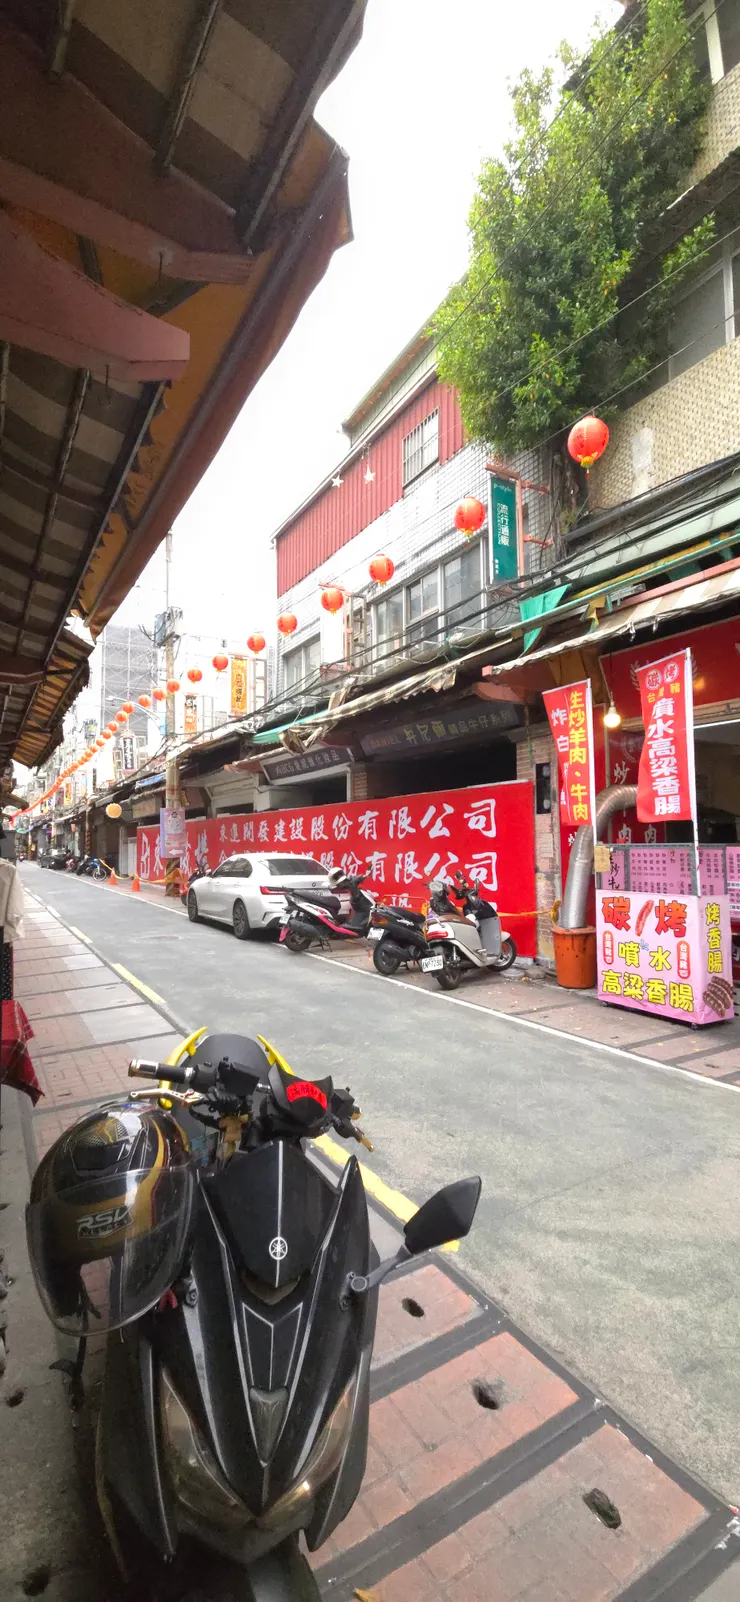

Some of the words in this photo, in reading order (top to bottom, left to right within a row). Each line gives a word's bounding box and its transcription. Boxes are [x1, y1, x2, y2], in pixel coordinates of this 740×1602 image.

[219, 798, 498, 843] 東進開發建設股份有限公司
[601, 895, 688, 938] 碳烤
[704, 902, 724, 975] 烤香腸
[617, 940, 673, 972] 噴水
